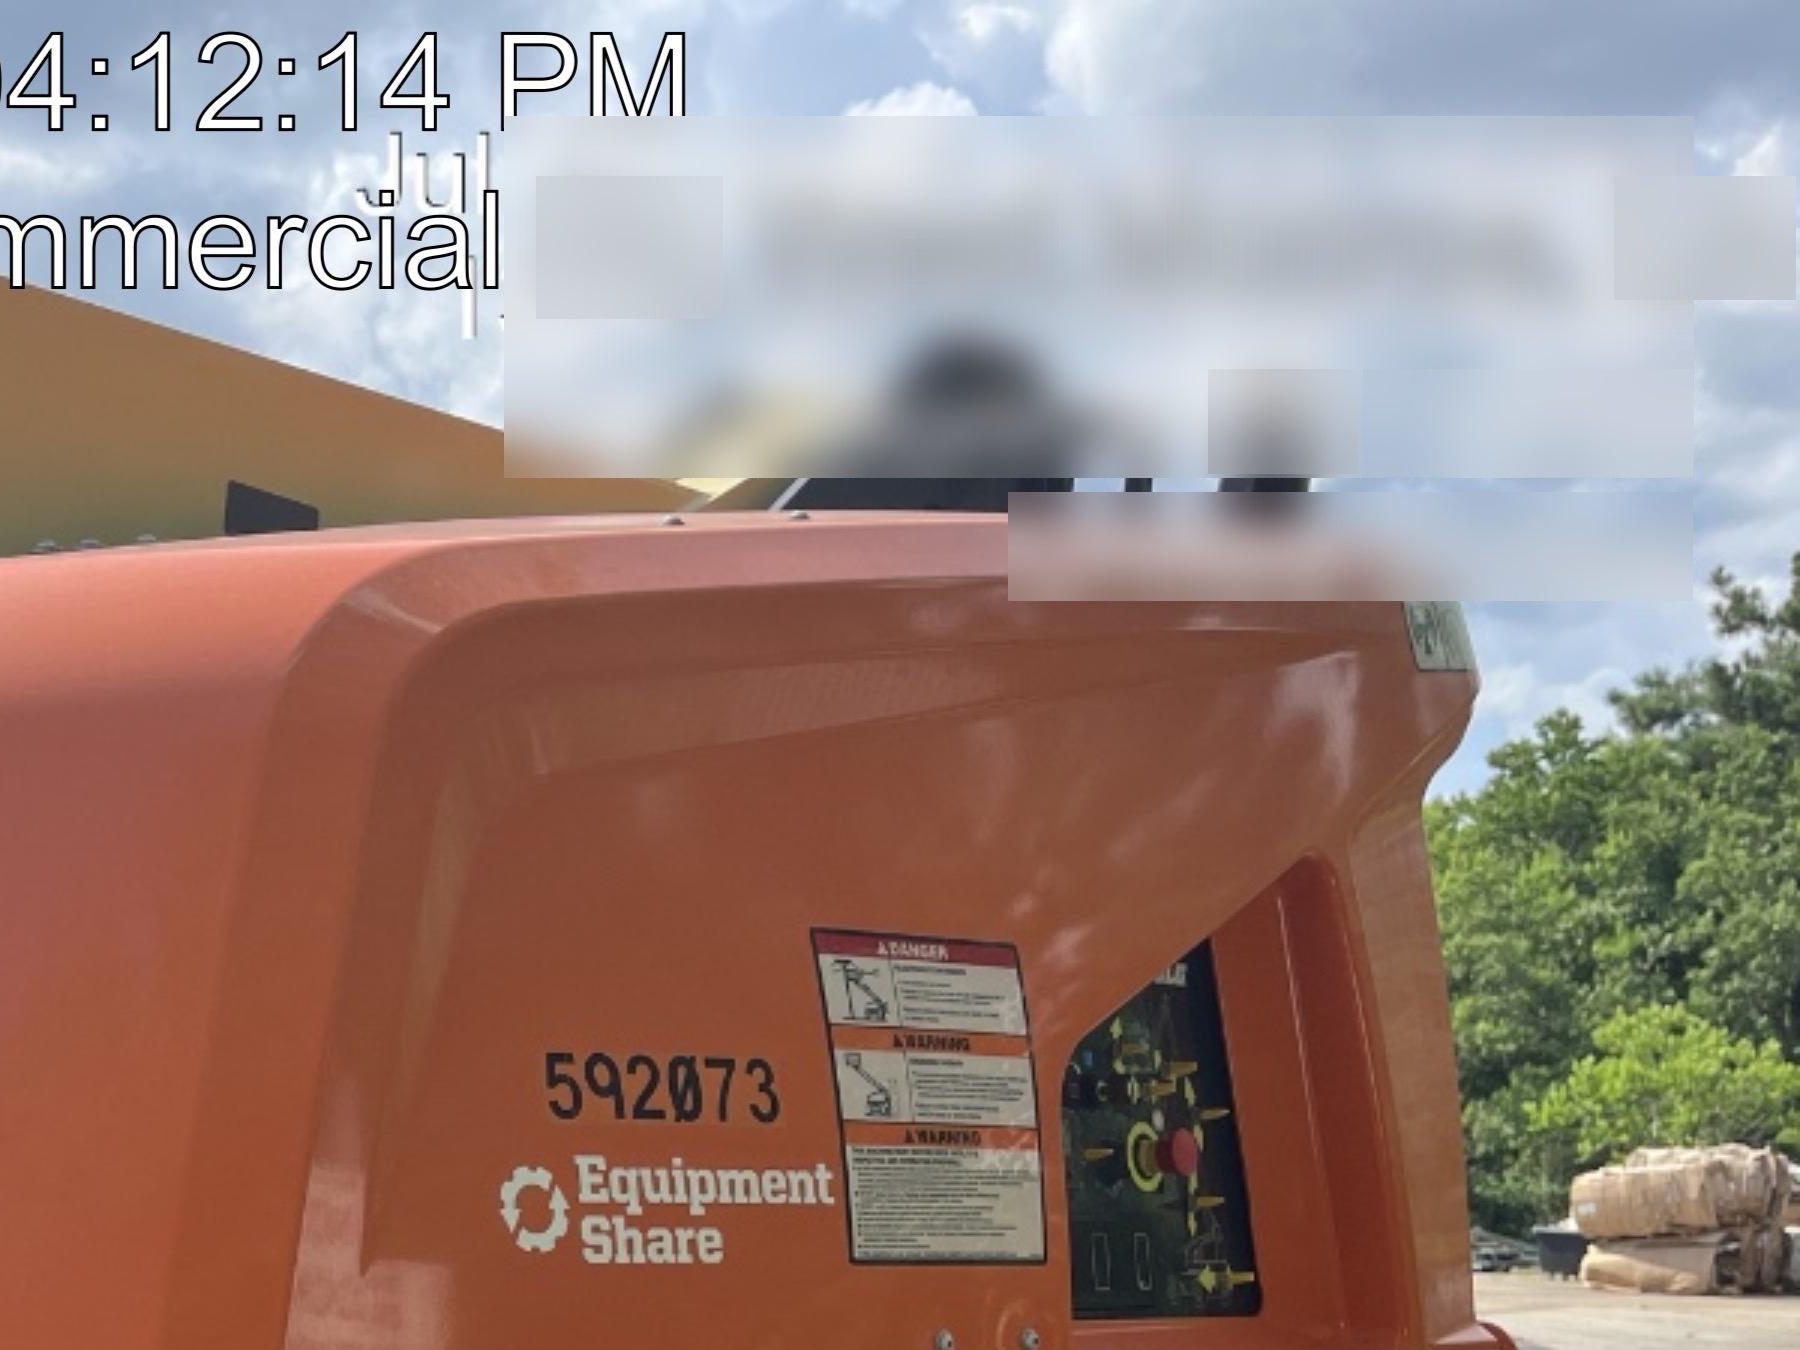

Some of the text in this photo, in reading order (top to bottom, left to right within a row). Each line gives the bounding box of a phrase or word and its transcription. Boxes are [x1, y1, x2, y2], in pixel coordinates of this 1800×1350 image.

[545, 1051, 781, 1122] 592073
[574, 1154, 835, 1216] Equipment
[580, 1214, 724, 1264] Share
